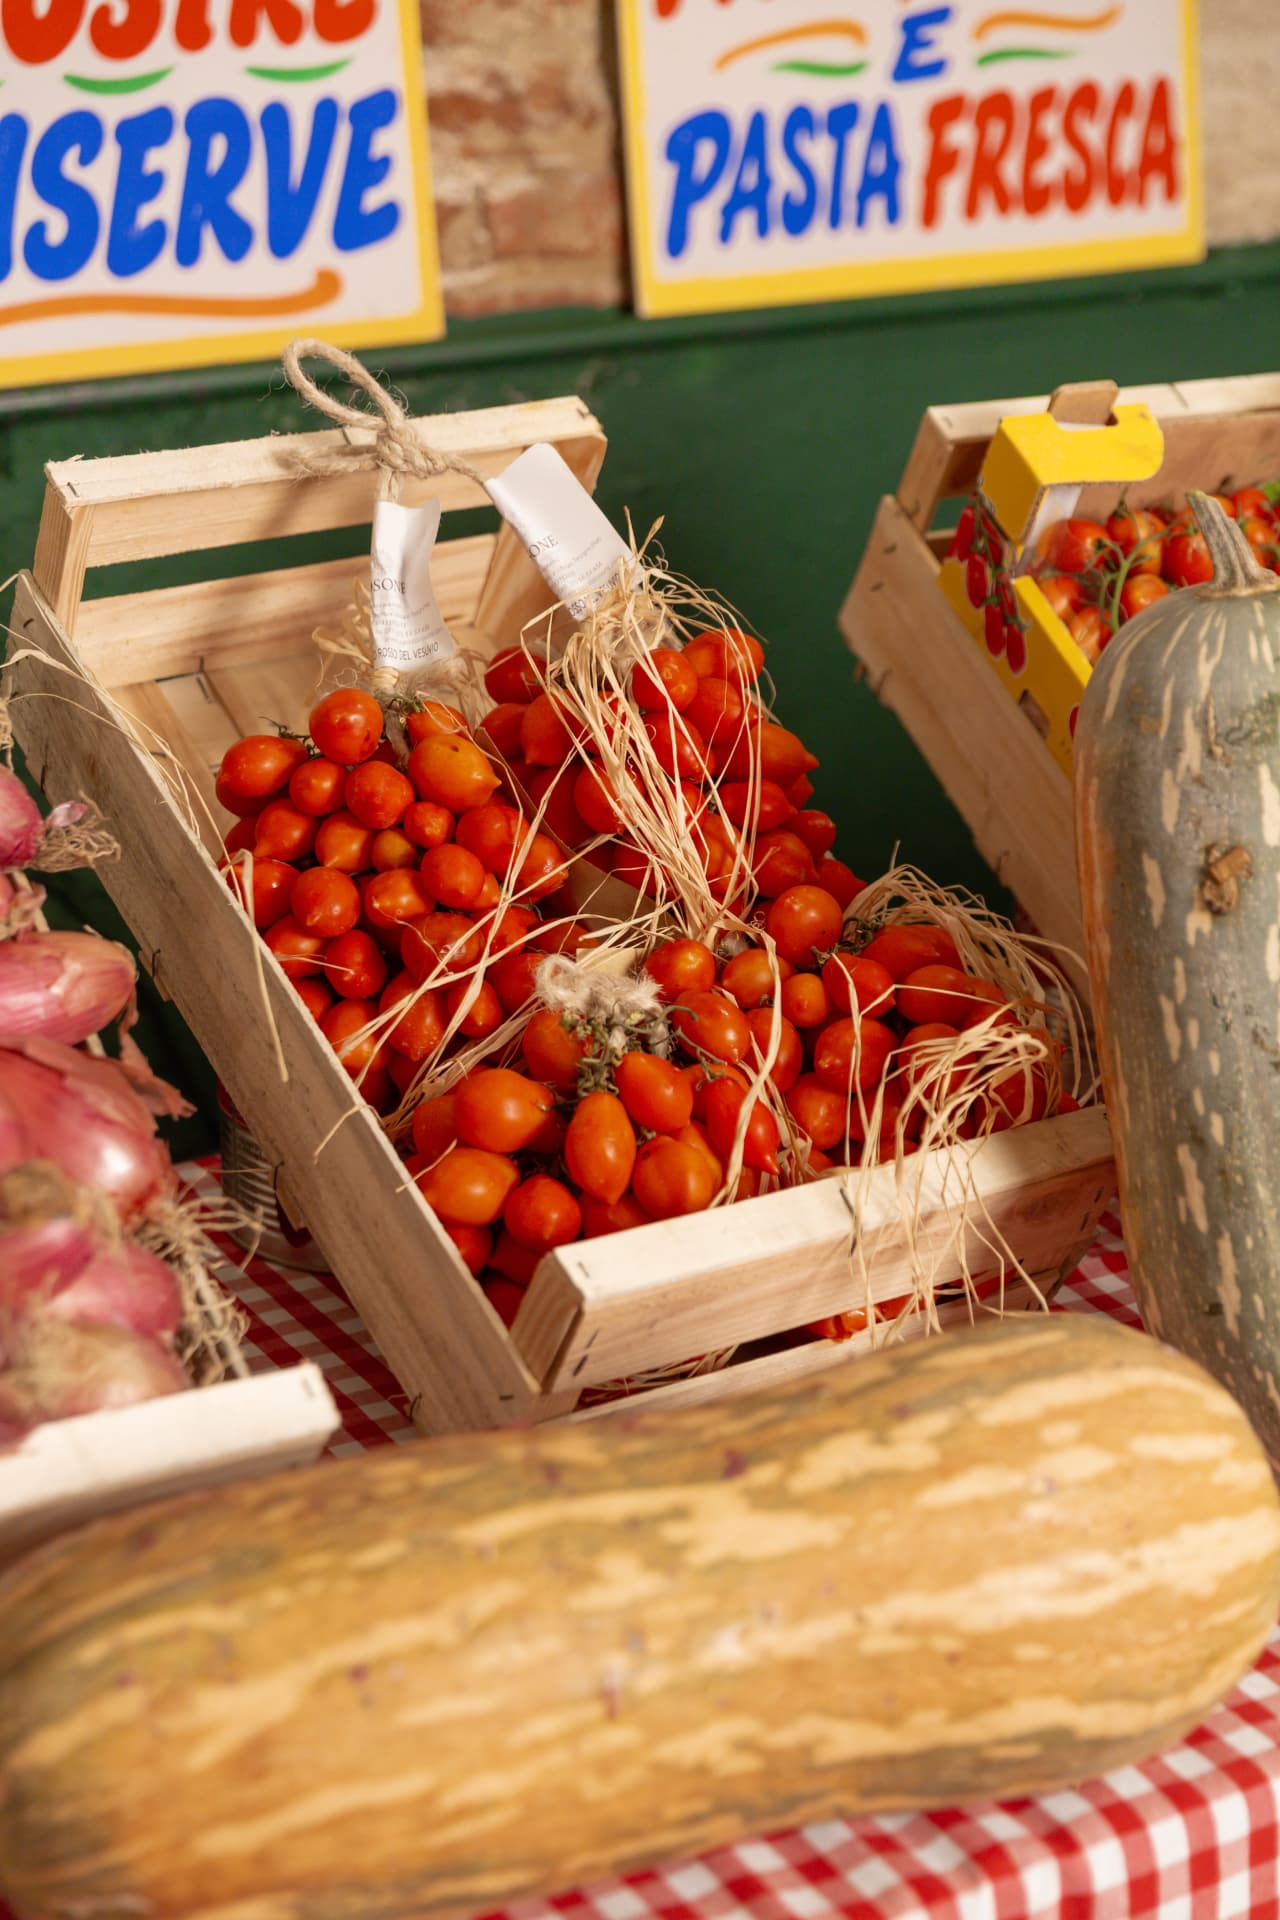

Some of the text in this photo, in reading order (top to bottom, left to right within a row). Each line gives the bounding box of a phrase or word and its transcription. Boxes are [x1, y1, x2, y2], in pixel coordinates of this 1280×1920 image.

[892, 7, 950, 83] E
[666, 80, 1177, 257] PASTA FRESCA
[370, 577, 406, 594] SONE
